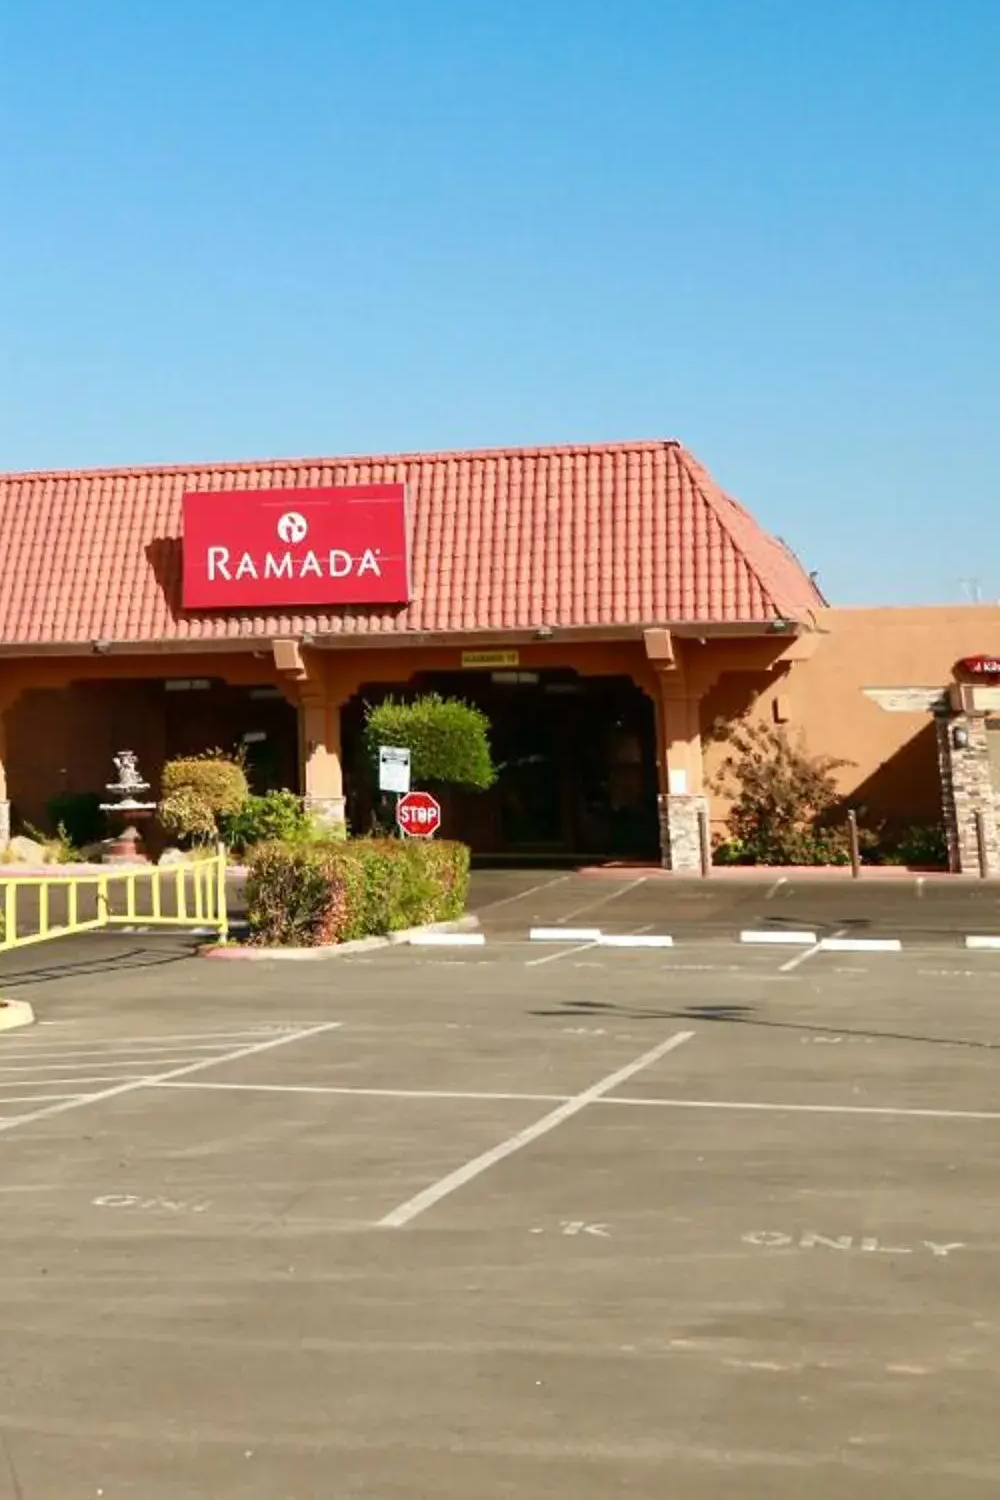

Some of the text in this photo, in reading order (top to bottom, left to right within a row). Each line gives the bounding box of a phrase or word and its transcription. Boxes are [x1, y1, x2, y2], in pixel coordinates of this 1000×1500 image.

[207, 547, 381, 580] RAMADA
[401, 806, 437, 824] STOP
[741, 1230, 966, 1256] ONLY
